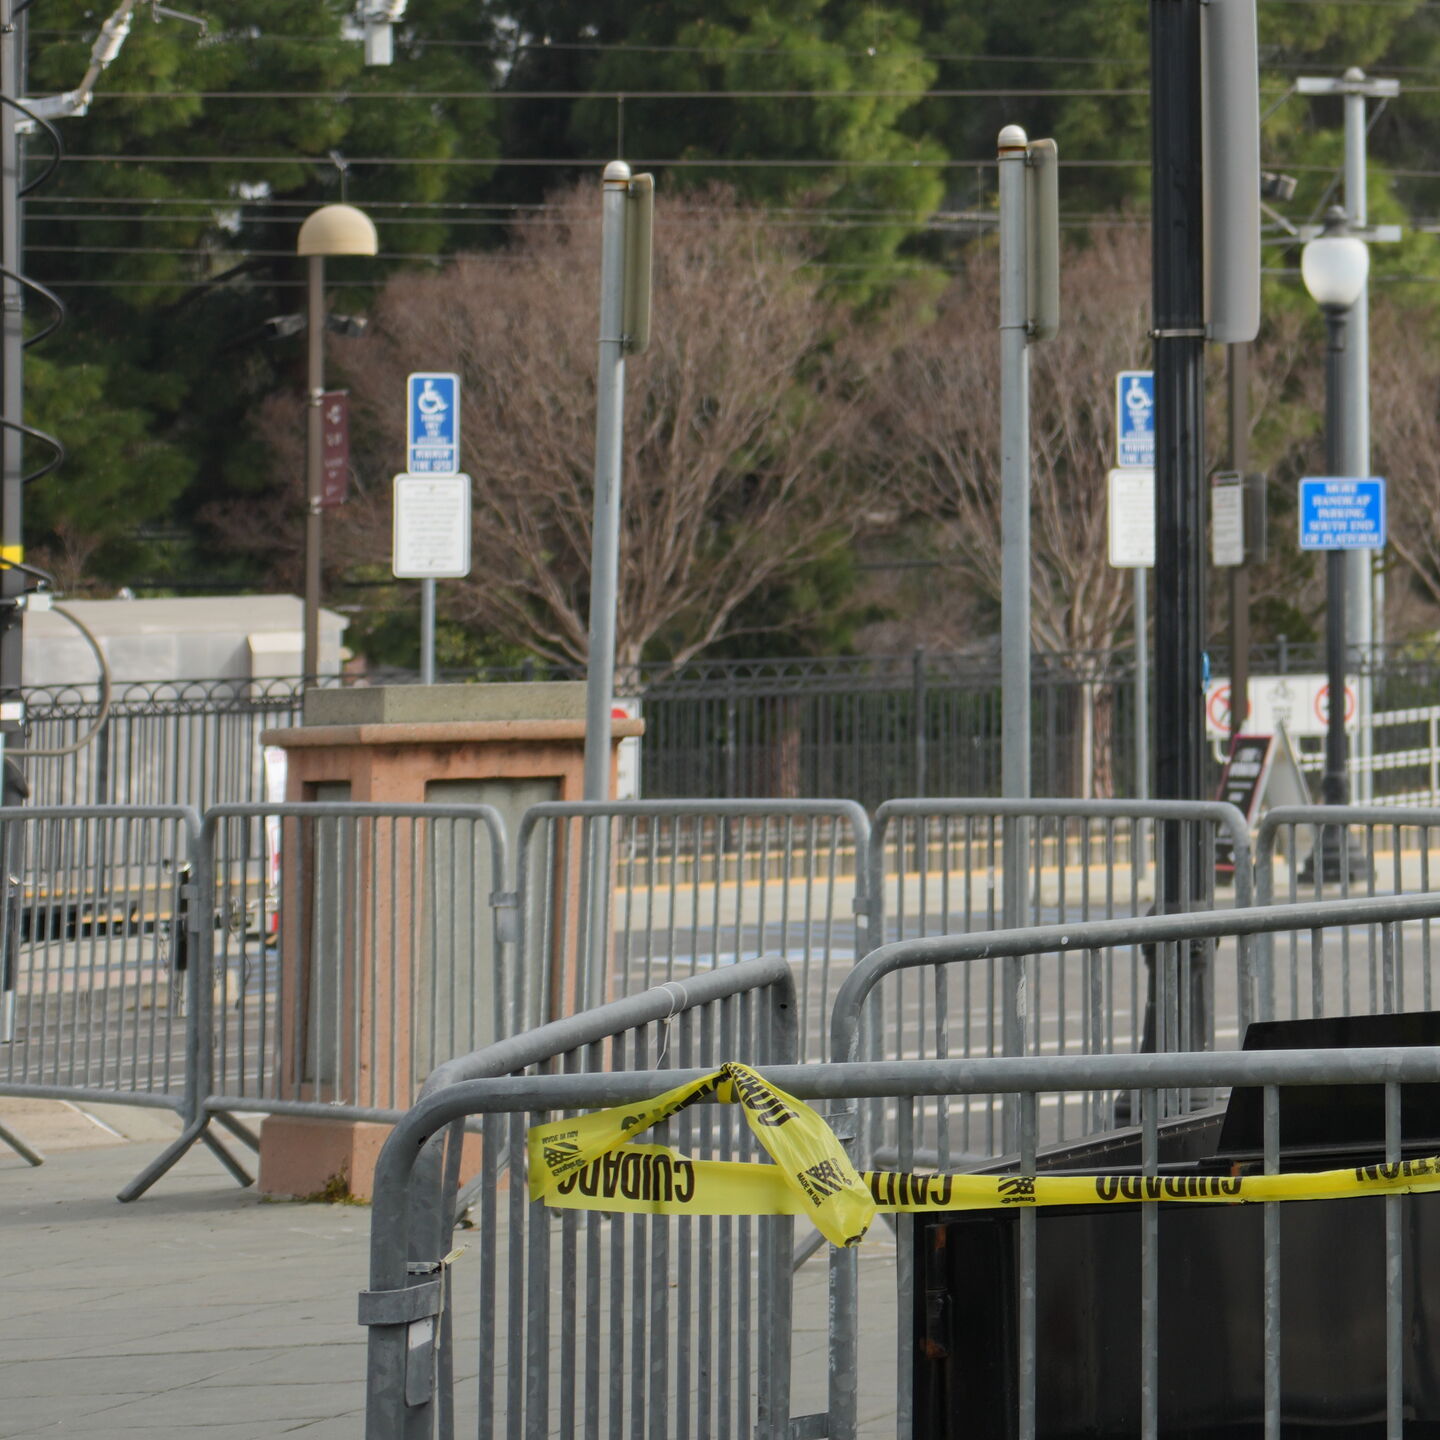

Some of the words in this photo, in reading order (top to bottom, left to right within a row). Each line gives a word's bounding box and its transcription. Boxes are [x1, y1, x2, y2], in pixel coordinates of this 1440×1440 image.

[1312, 495, 1371, 507] HANDICAP
[1318, 508, 1366, 519] PARKING
[1309, 521, 1347, 531] SOUTH
[1350, 520, 1375, 531] END
[1322, 533, 1379, 544] PLATFORM
[797, 1172, 809, 1190] MADE
[812, 1194, 823, 1208] USA
